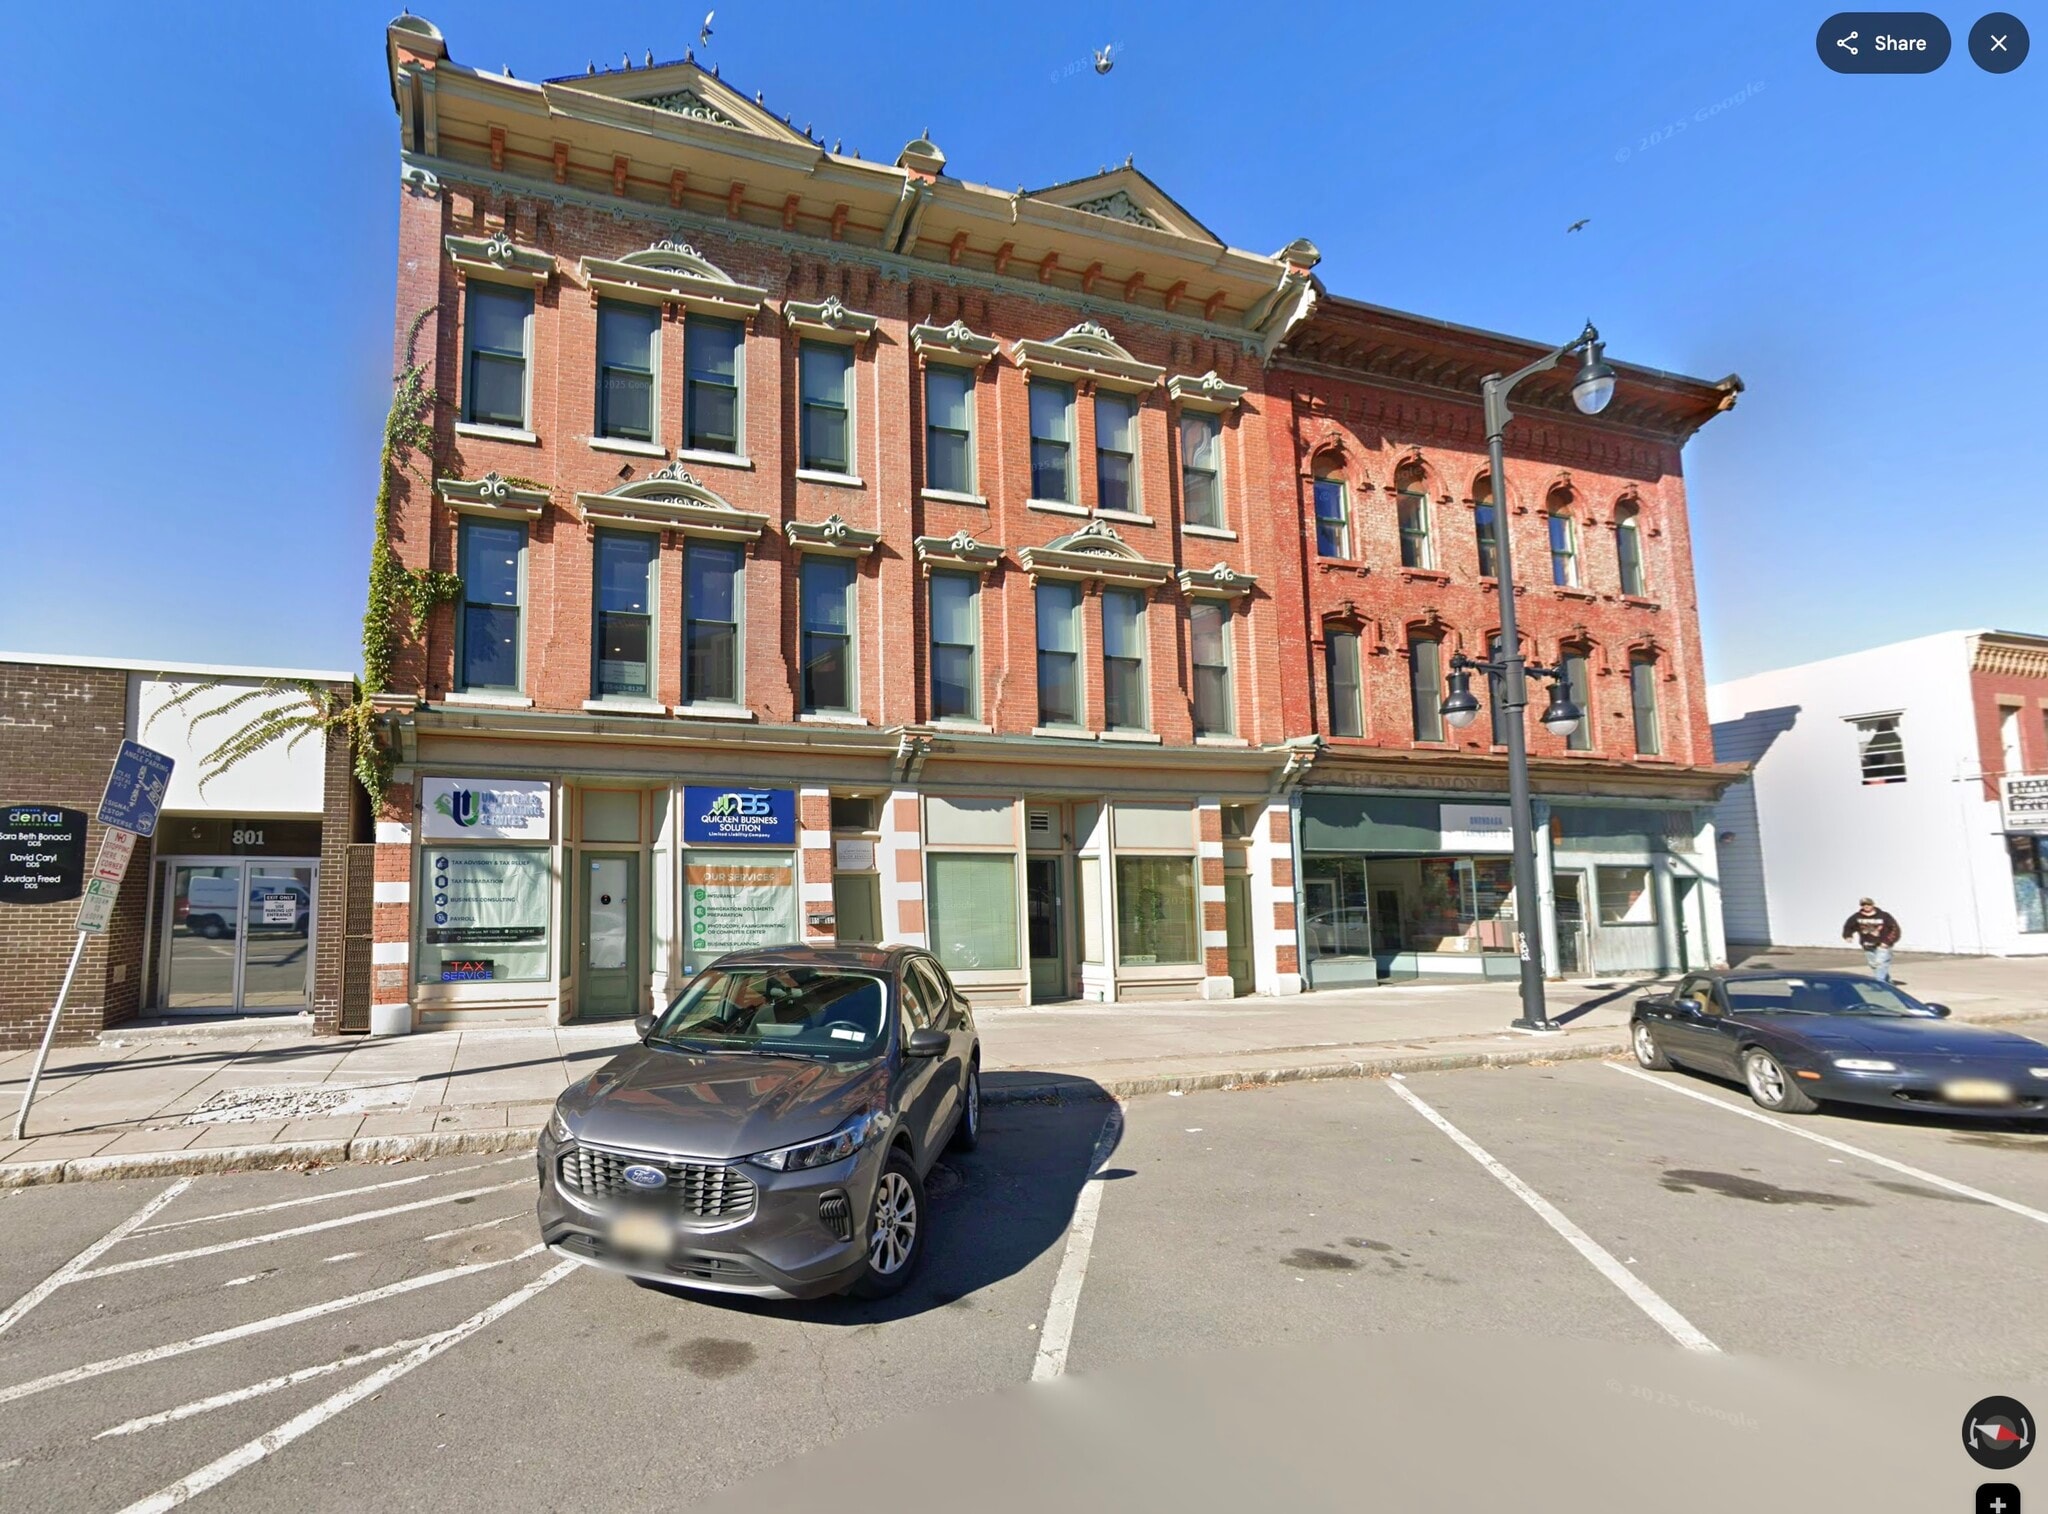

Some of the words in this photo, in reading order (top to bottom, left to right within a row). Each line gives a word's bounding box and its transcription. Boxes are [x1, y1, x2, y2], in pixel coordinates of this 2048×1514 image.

[124, 750, 143, 763] ANGLE
[144, 757, 169, 772] PARKING
[1418, 775, 1480, 790] SIMON
[9, 811, 63, 823] dental
[701, 815, 739, 824] QUICKEN
[741, 816, 778, 825] BUSINESS
[719, 824, 761, 832] SOLUTION
[0, 832, 17, 840] Sara
[18, 832, 36, 840] Beth
[115, 832, 127, 843] NO
[232, 830, 265, 845] 801
[105, 841, 130, 854] STOPPING
[10, 854, 34, 862] David
[36, 854, 57, 863] Caryl
[103, 850, 117, 860] HERE
[120, 854, 127, 862] TO
[101, 860, 123, 870] CORNER
[3, 875, 36, 883] Jourdan
[37, 875, 61, 883] Freed
[704, 872, 726, 881] OUR
[728, 873, 776, 881] SERVICES
[90, 880, 100, 894] 2
[451, 962, 485, 971] TAX
[442, 971, 493, 980] SERVICE
